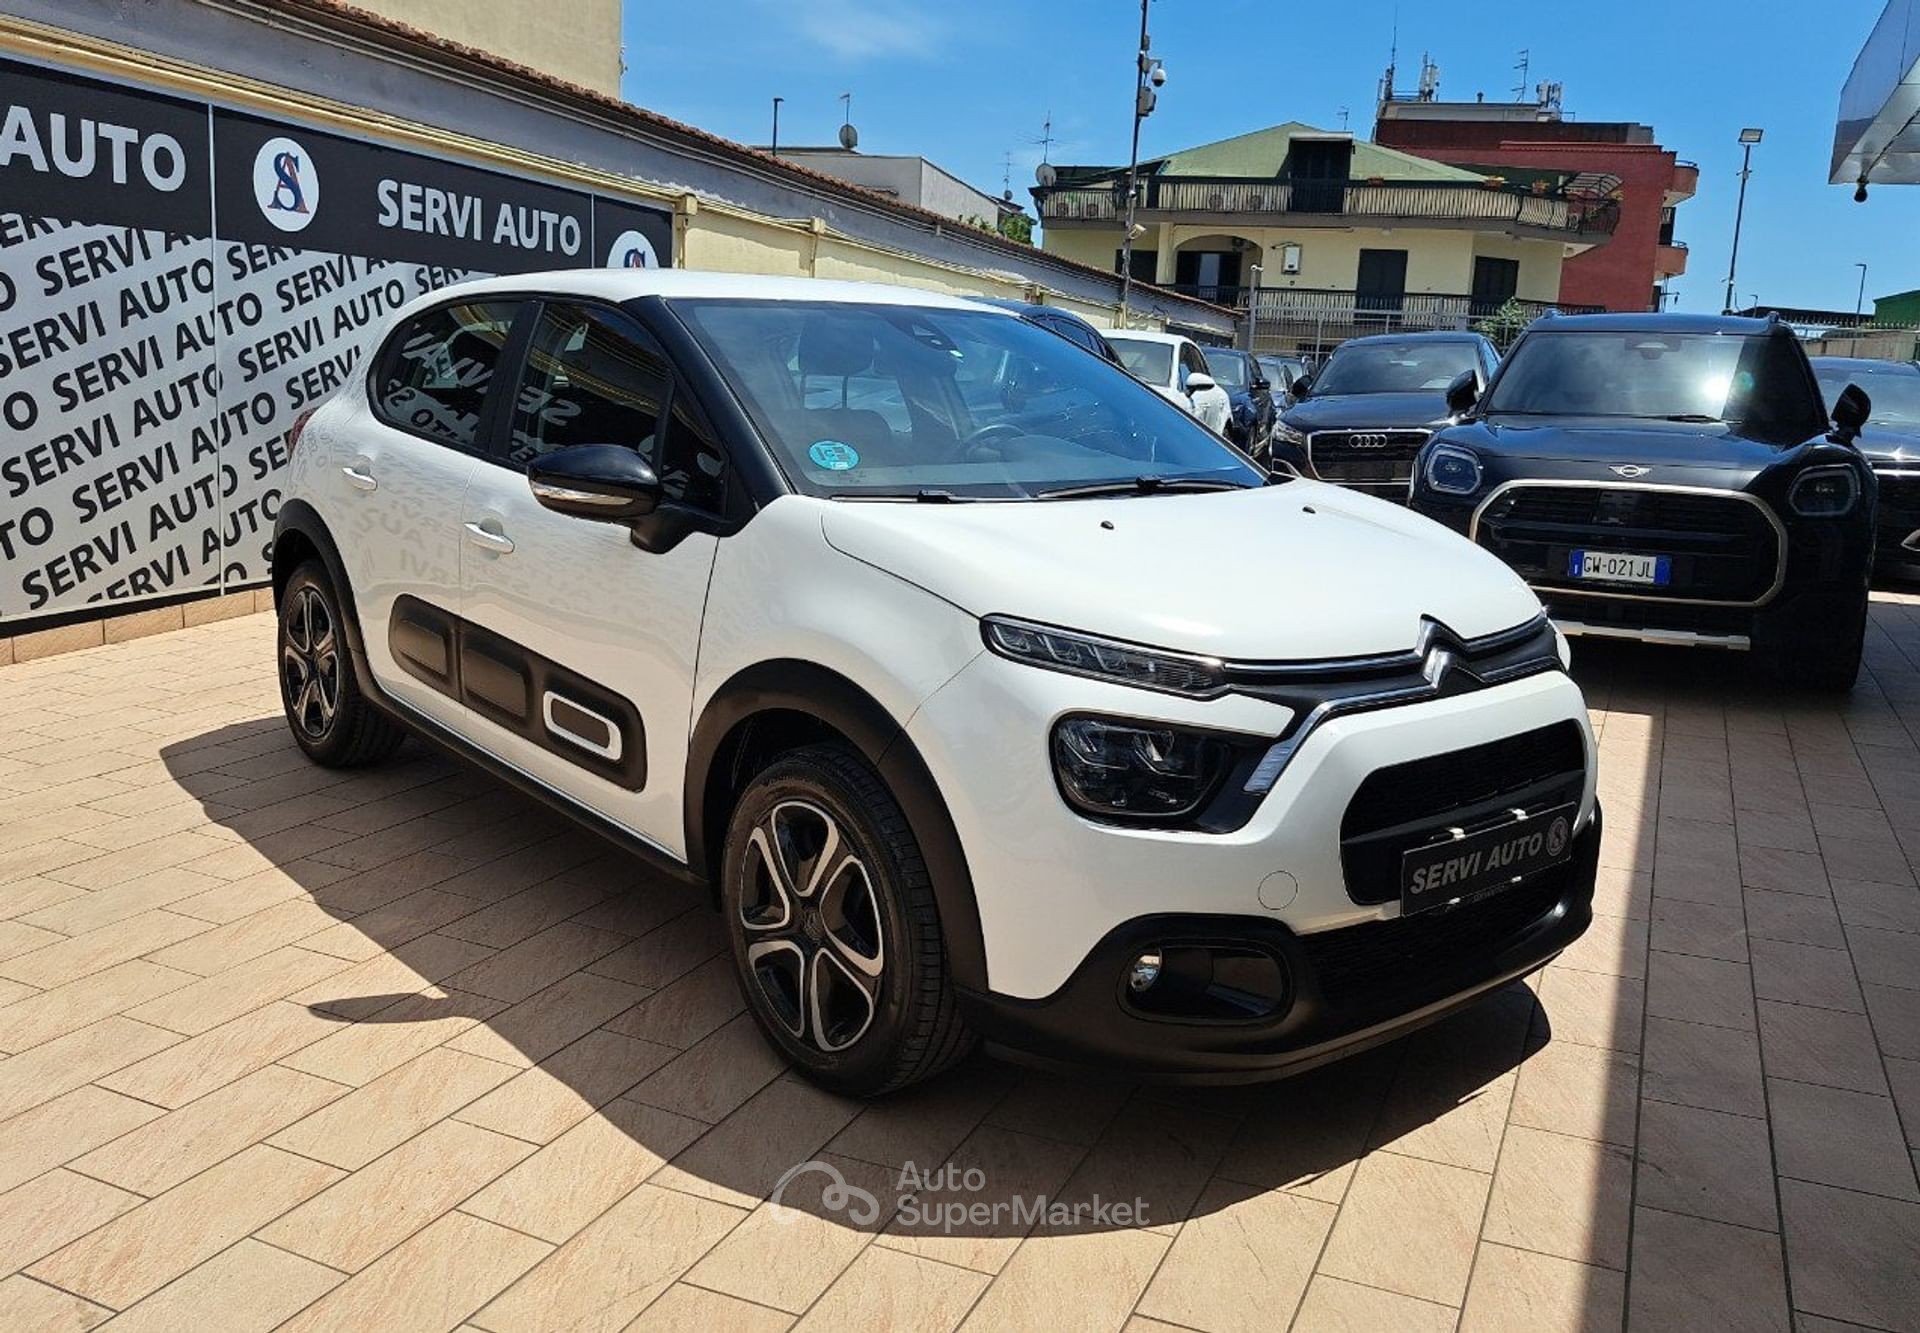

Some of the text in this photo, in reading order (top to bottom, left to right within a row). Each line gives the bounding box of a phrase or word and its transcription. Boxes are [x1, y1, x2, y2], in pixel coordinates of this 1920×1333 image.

[0, 104, 187, 192] AUTO
[377, 178, 582, 256] SERVI AUTO
[36, 227, 151, 297] SERVI
[120, 258, 214, 328] AUTO
[52, 335, 164, 413] SERVI
[176, 292, 262, 361] AUTO
[276, 254, 356, 313] SERVI
[1, 413, 120, 498] SERVI
[132, 363, 224, 437] AUTO
[238, 316, 325, 383] SERVI
[334, 279, 405, 338] AUTO
[72, 441, 180, 524] SERVI
[191, 392, 275, 464] AUTO
[22, 464, 238, 610] SERVI AUTO
[1410, 851, 1482, 894] SERVI
[1484, 832, 1543, 872] AUTO
